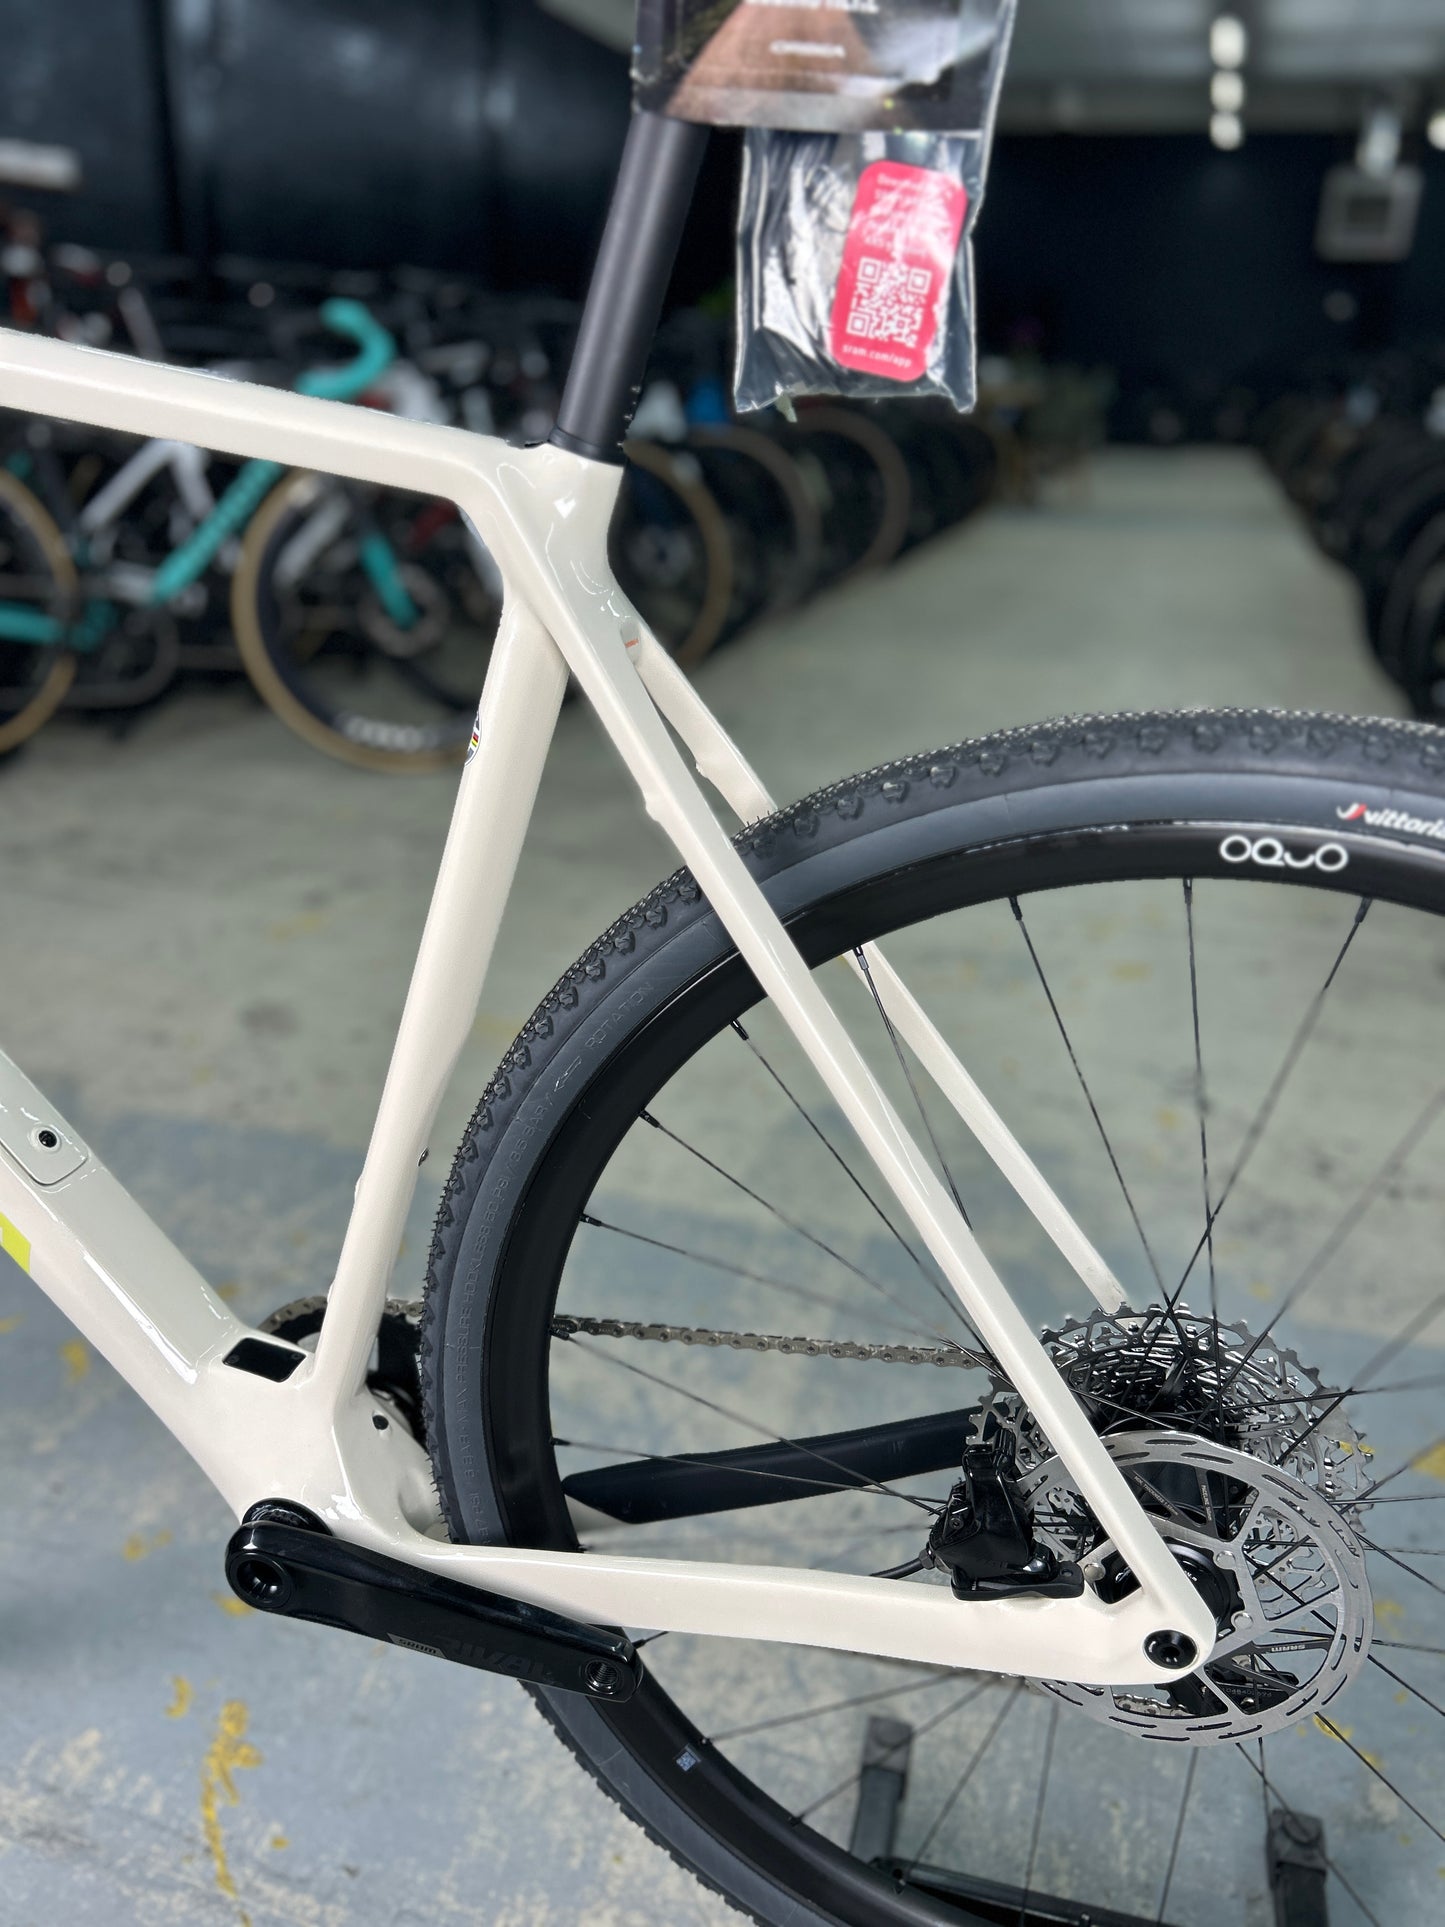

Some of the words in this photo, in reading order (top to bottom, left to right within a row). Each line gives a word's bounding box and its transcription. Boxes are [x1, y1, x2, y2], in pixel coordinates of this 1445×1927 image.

[842, 344, 912, 368] sram.com/app
[585, 980, 653, 1051] ROTATION
[455, 1306, 473, 1384] PRESSURE
